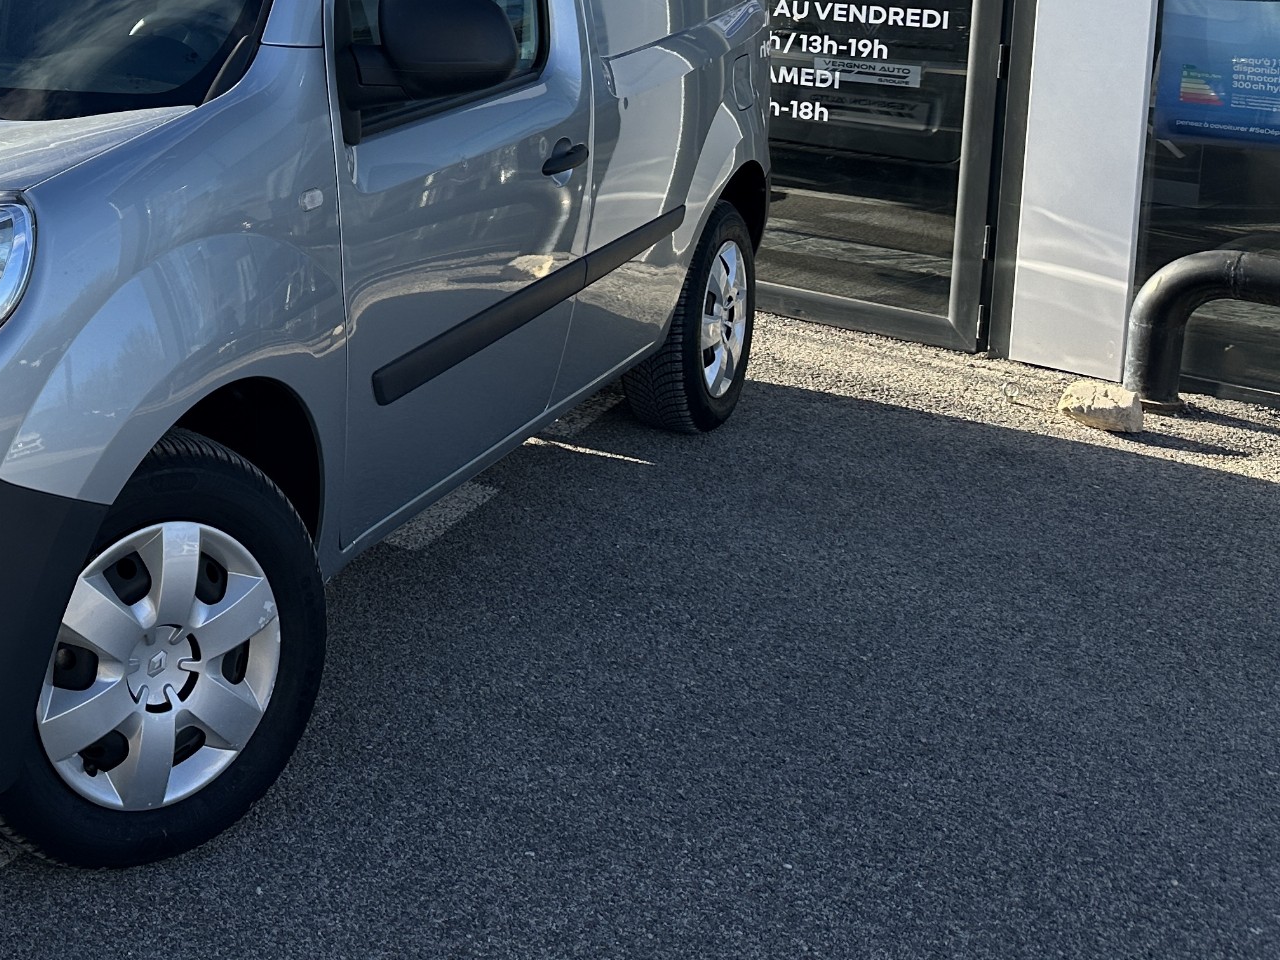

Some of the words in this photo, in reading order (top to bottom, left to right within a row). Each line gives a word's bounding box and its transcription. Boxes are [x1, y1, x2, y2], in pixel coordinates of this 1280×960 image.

[773, 0, 810, 19] AU
[814, 1, 950, 30] VENDREDI
[799, 34, 889, 60] 13h-19h
[823, 59, 876, 71] VERGNON
[878, 65, 911, 74] AUTO
[1233, 64, 1280, 75] disponibl
[877, 77, 910, 86] GROUPE
[1232, 81, 1251, 89] 300
[769, 96, 829, 122] h-18h
